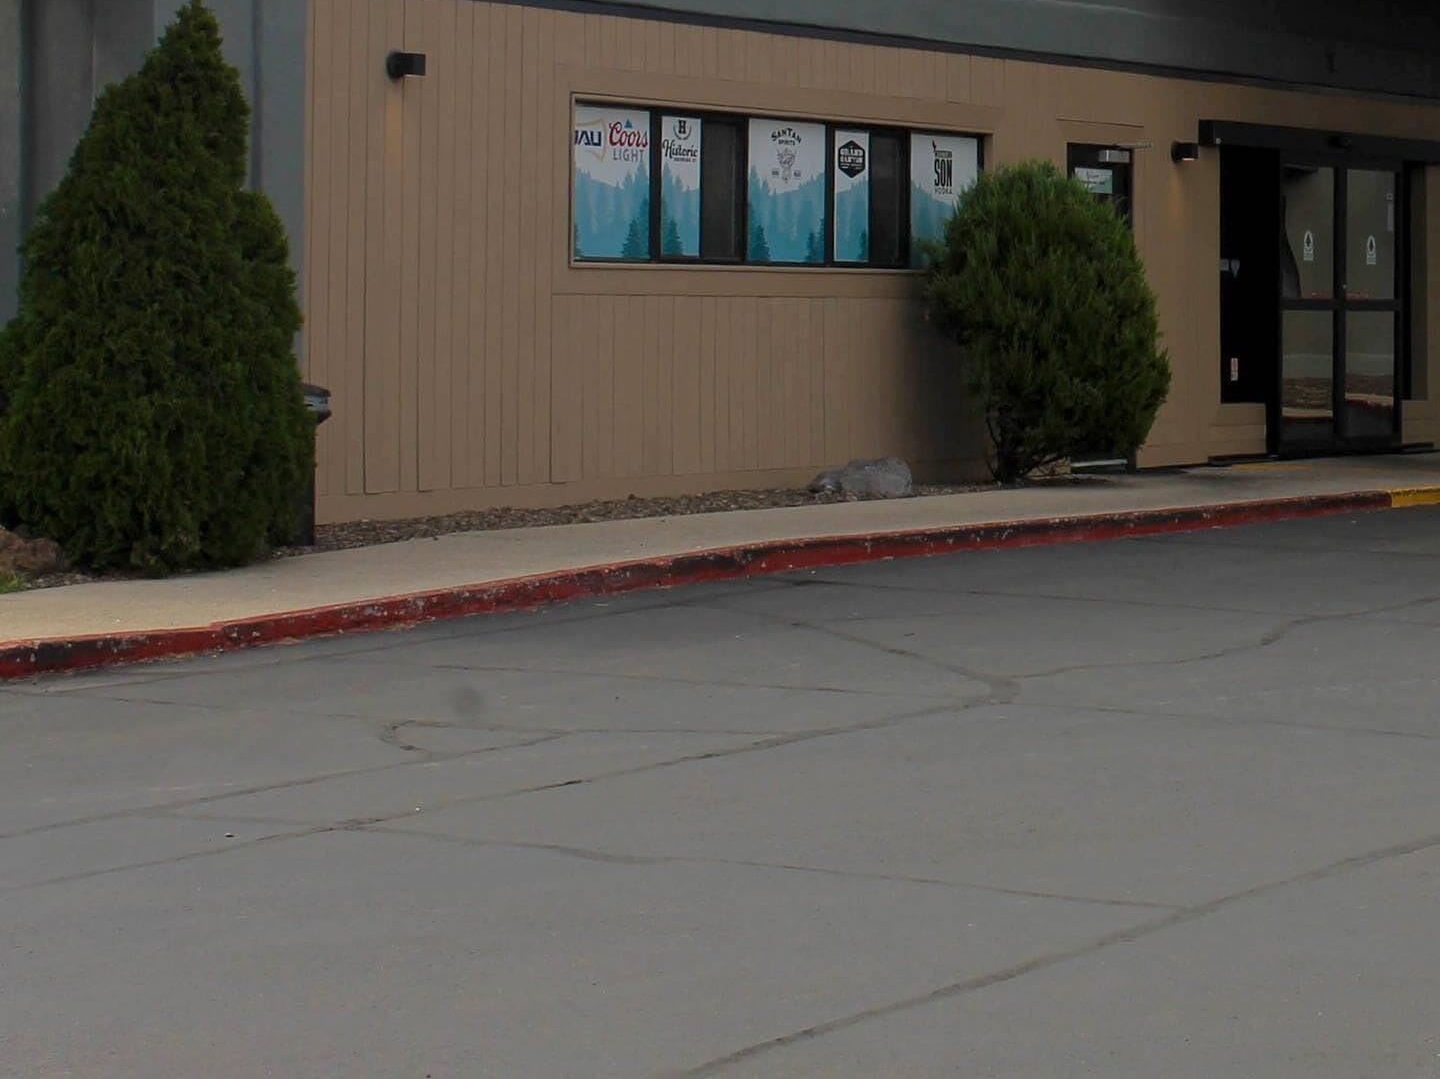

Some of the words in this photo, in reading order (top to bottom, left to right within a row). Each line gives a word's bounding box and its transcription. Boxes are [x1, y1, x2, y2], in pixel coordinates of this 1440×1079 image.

[609, 121, 649, 148] Coors
[678, 120, 686, 134] H
[613, 149, 645, 162] LIGHT
[662, 139, 698, 158] Historic
[934, 158, 953, 187] SON
